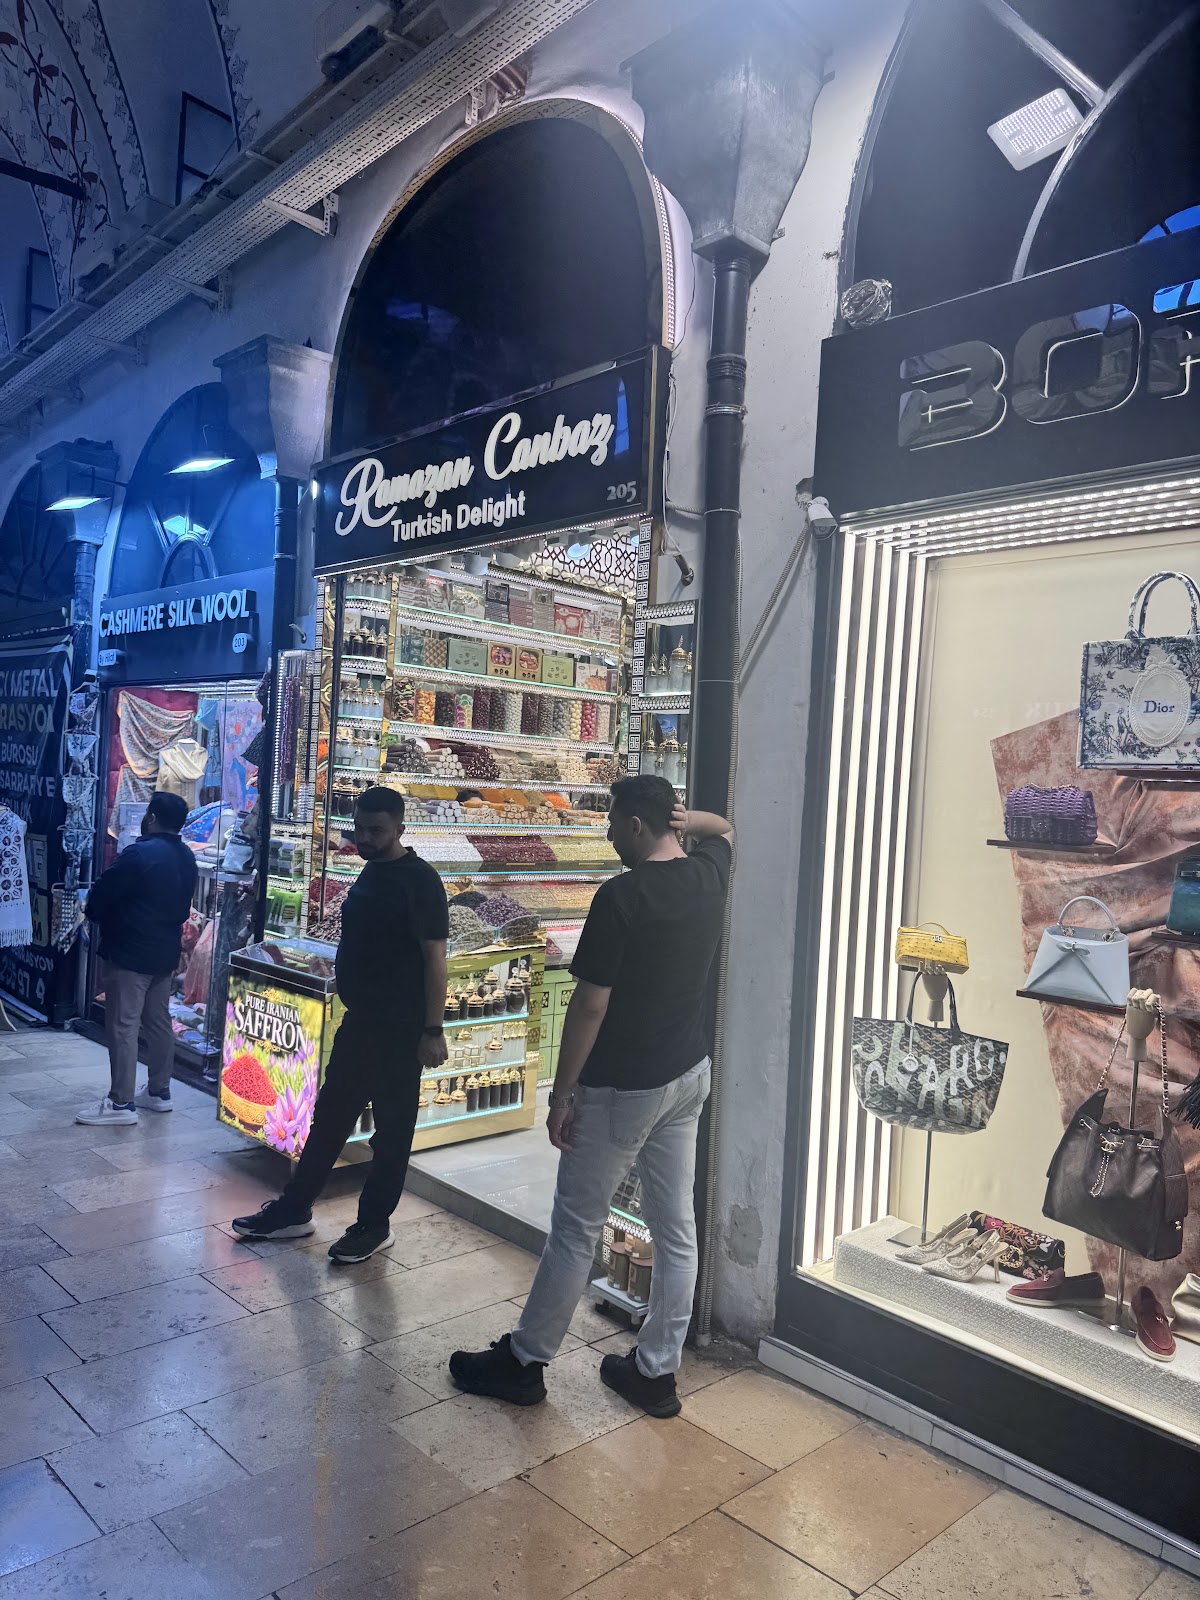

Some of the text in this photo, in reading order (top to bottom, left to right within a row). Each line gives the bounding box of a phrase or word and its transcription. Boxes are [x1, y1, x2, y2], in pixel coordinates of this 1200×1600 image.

[335, 412, 615, 536] Ramazan Canbaz
[607, 481, 637, 502] 205
[391, 490, 526, 543] Turkish Delight
[100, 588, 250, 638] CASHMERE SILK WOOL
[234, 637, 246, 649] 203
[10, 667, 58, 697] METAL
[1143, 700, 1175, 714] Dior
[1, 735, 39, 766] BÜROSU
[245, 994, 301, 1024] PURE IRANIAN
[235, 1001, 309, 1055] SAFFRON
